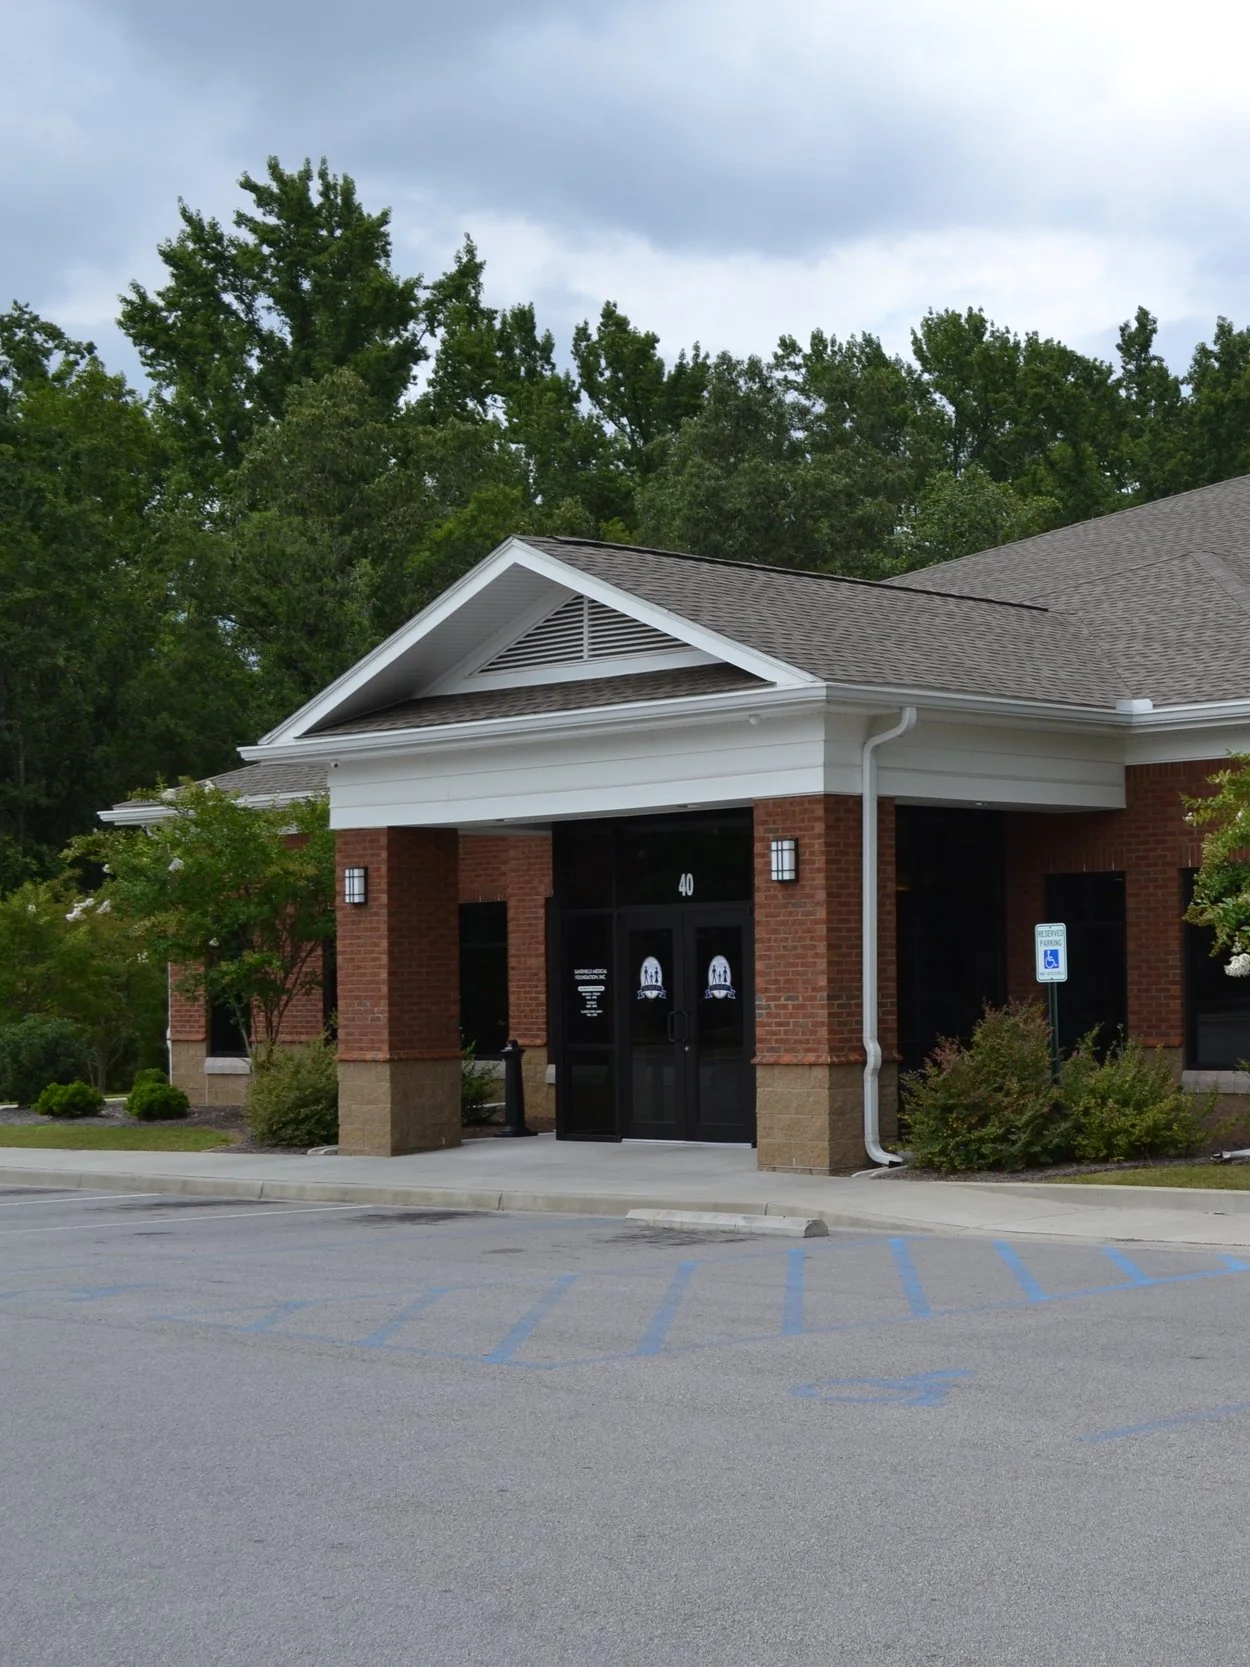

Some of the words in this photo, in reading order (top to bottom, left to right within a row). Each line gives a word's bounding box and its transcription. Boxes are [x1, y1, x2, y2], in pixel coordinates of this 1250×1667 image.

[679, 873, 694, 896] 40
[1038, 929, 1064, 938] RESERVED
[1039, 939, 1062, 947] PARKING
